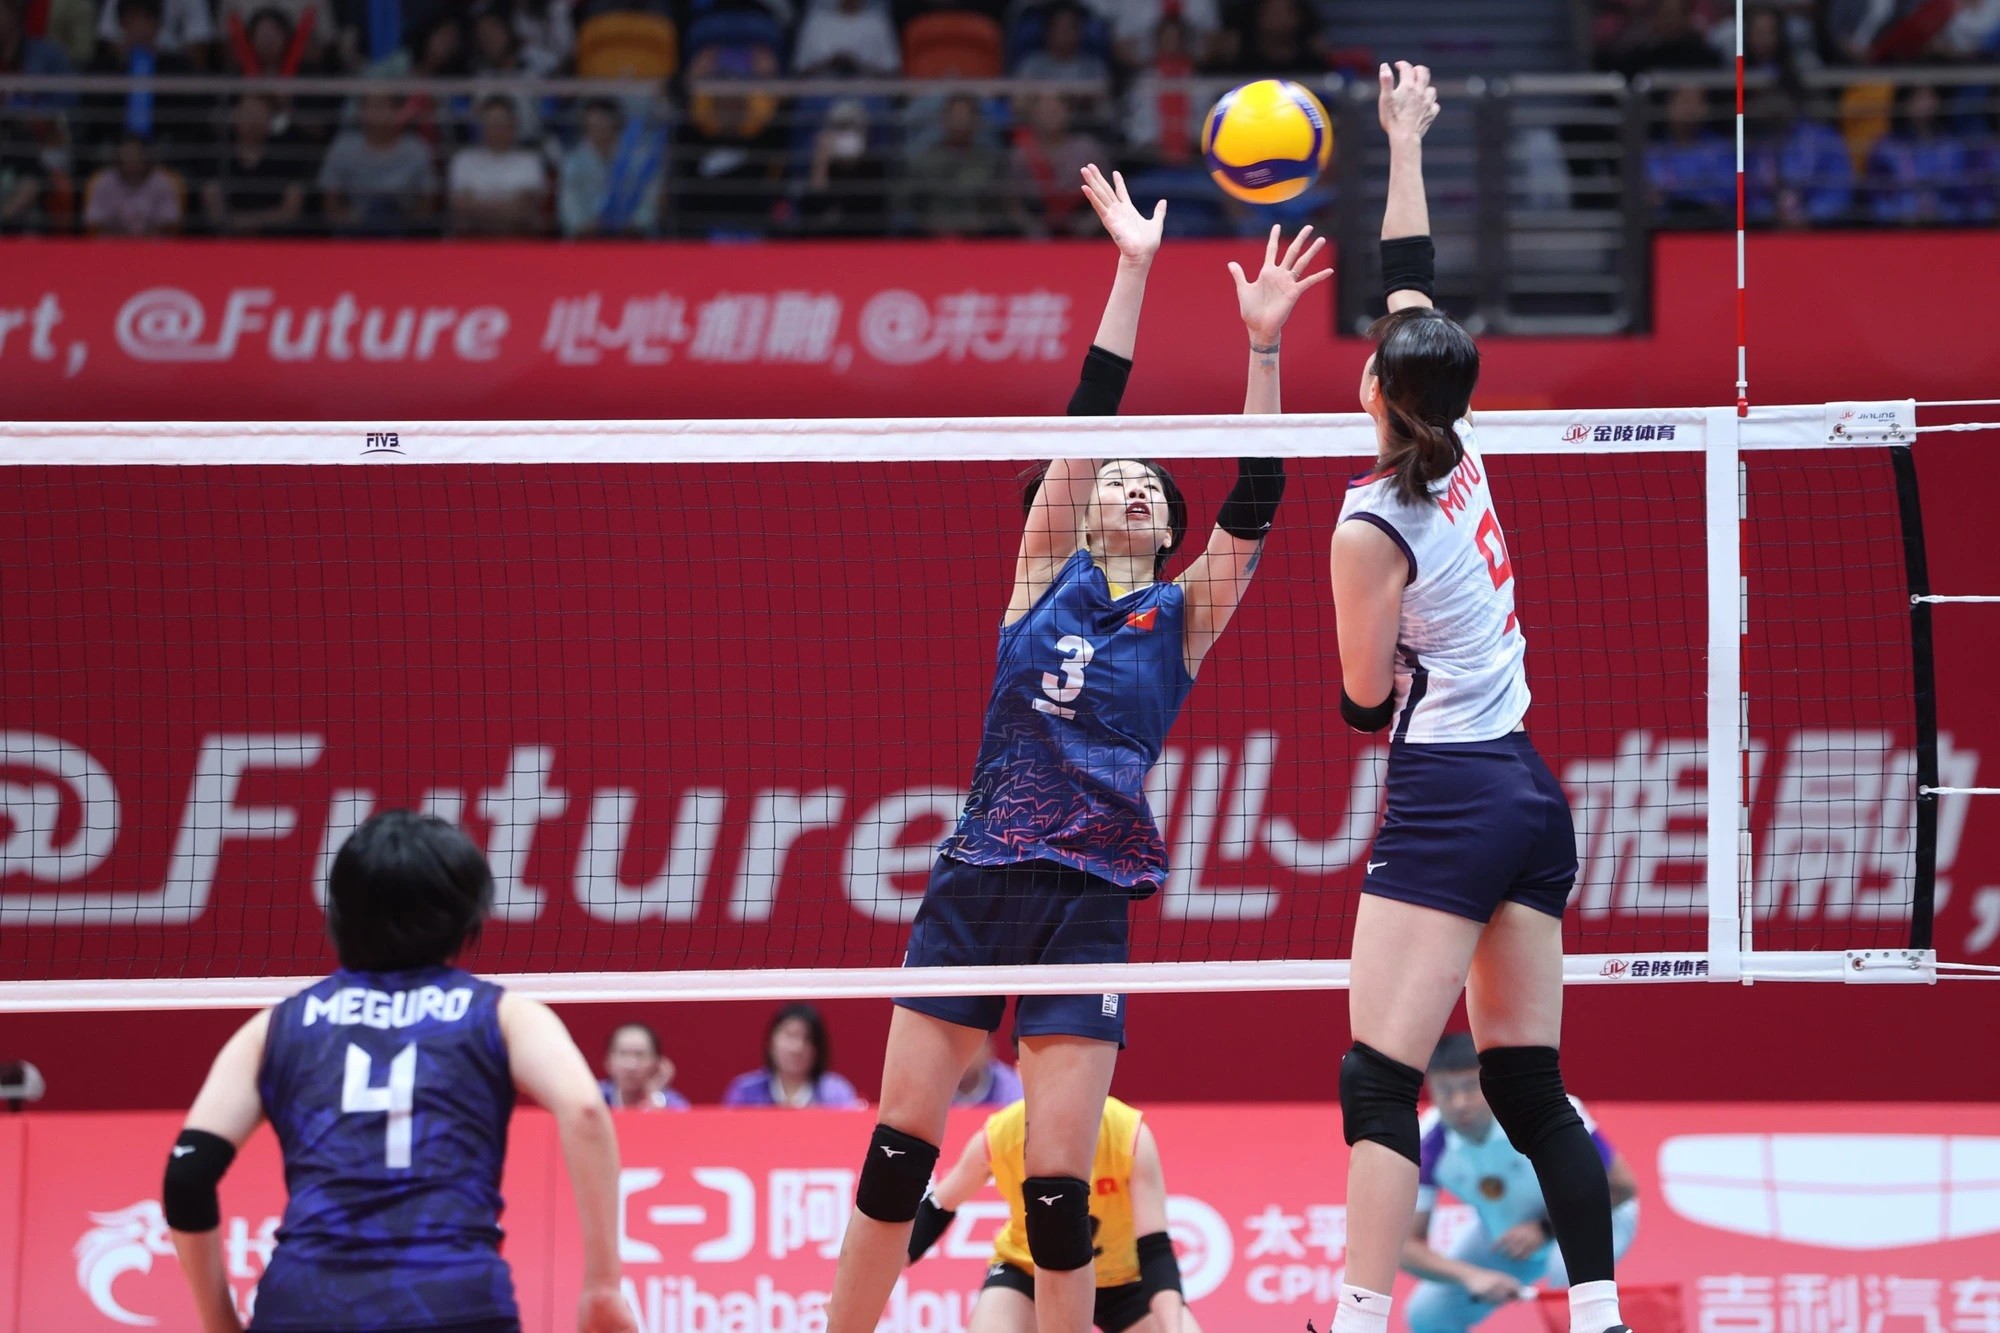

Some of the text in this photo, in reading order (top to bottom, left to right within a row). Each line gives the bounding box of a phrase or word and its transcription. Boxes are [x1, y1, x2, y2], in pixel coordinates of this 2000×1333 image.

[114, 286, 509, 362] @Future
[366, 432, 399, 447] FIVB
[1593, 425, 1676, 441] 金陵体育
[1436, 451, 1481, 526] MIYU
[1041, 634, 1095, 703] 3
[1631, 959, 1709, 977] 金陵体育
[302, 985, 474, 1030] MEGURO
[341, 1039, 417, 1169] 4
[1245, 1264, 1345, 1305] CPI
